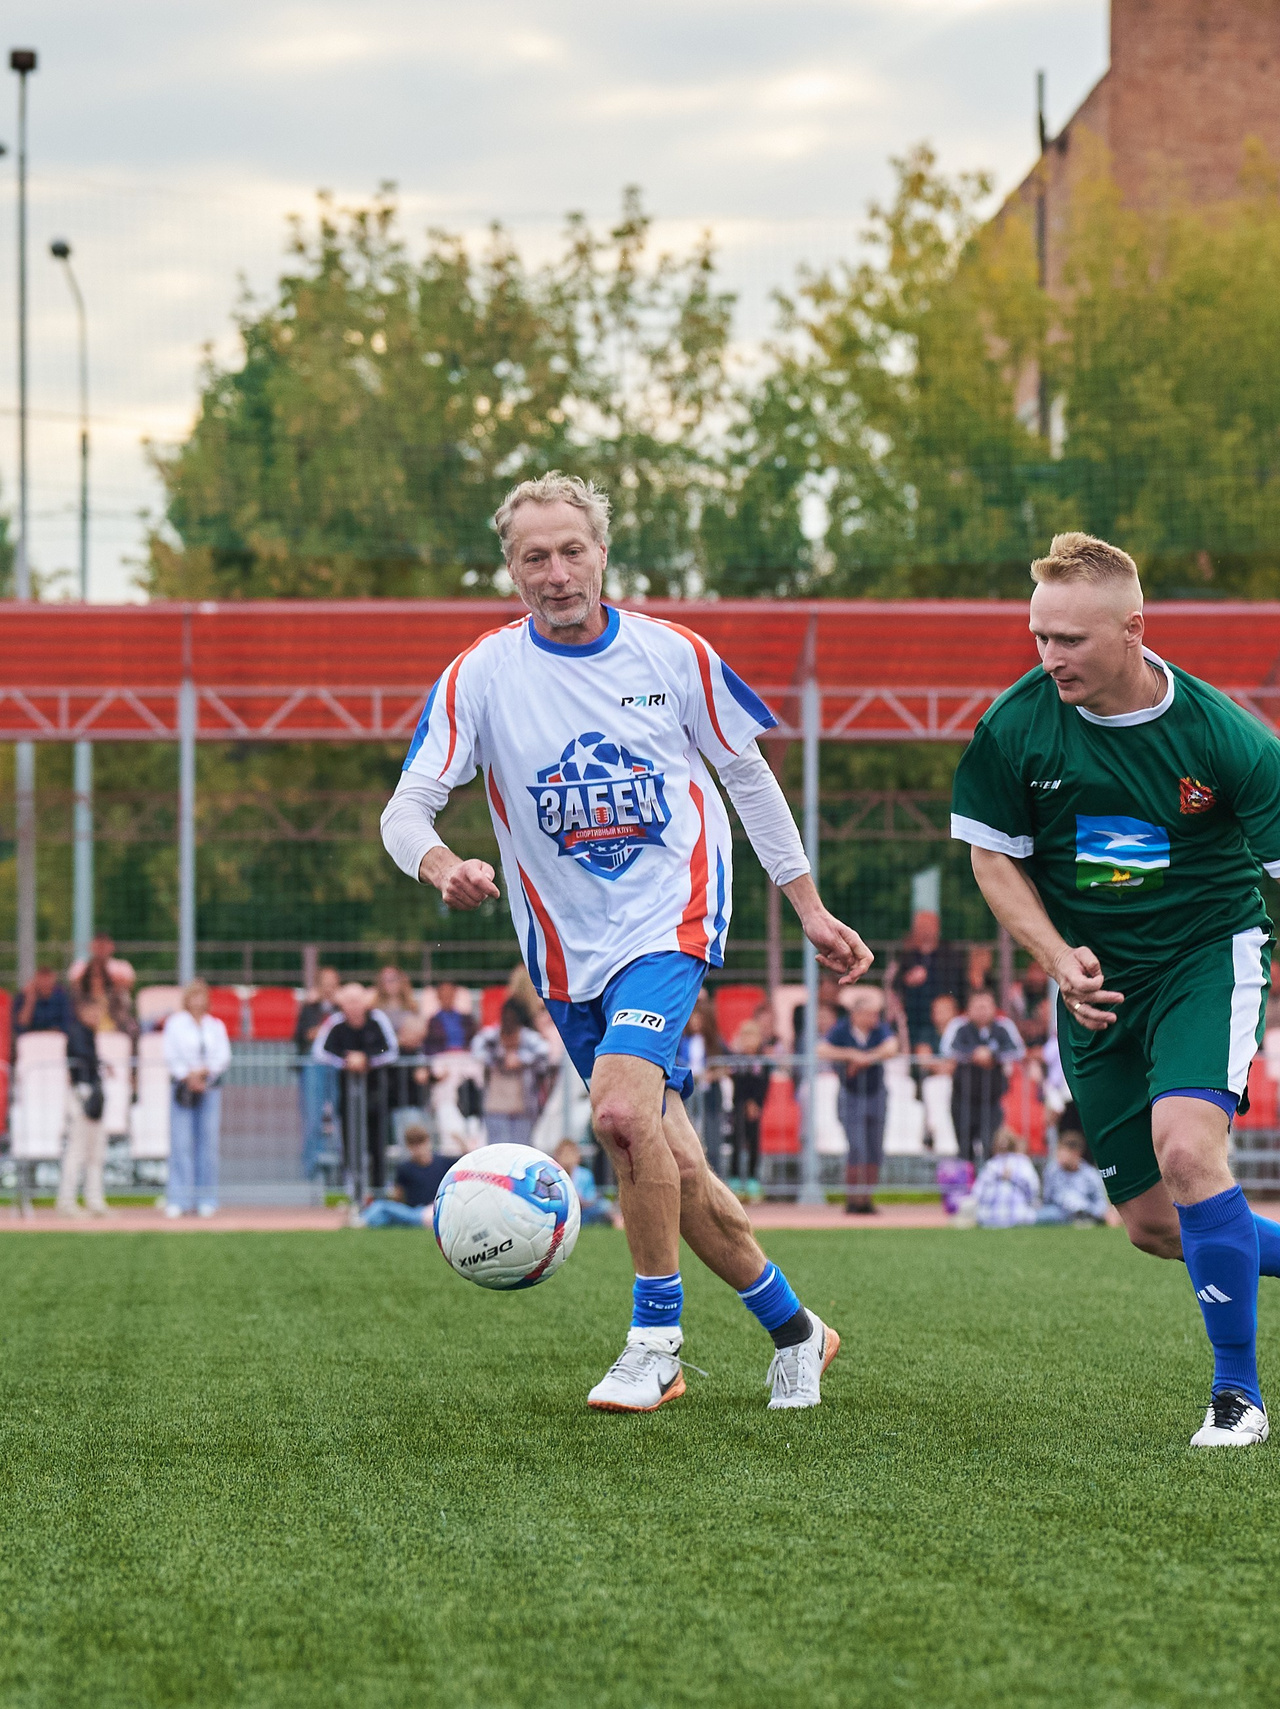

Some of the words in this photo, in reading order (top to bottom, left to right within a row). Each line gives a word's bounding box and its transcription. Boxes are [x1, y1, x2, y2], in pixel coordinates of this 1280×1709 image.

[621, 692, 666, 707] PARI
[540, 772, 666, 834] ЗАБЕЙ
[614, 1011, 663, 1028] PARI
[458, 1239, 514, 1268] DEMIX
